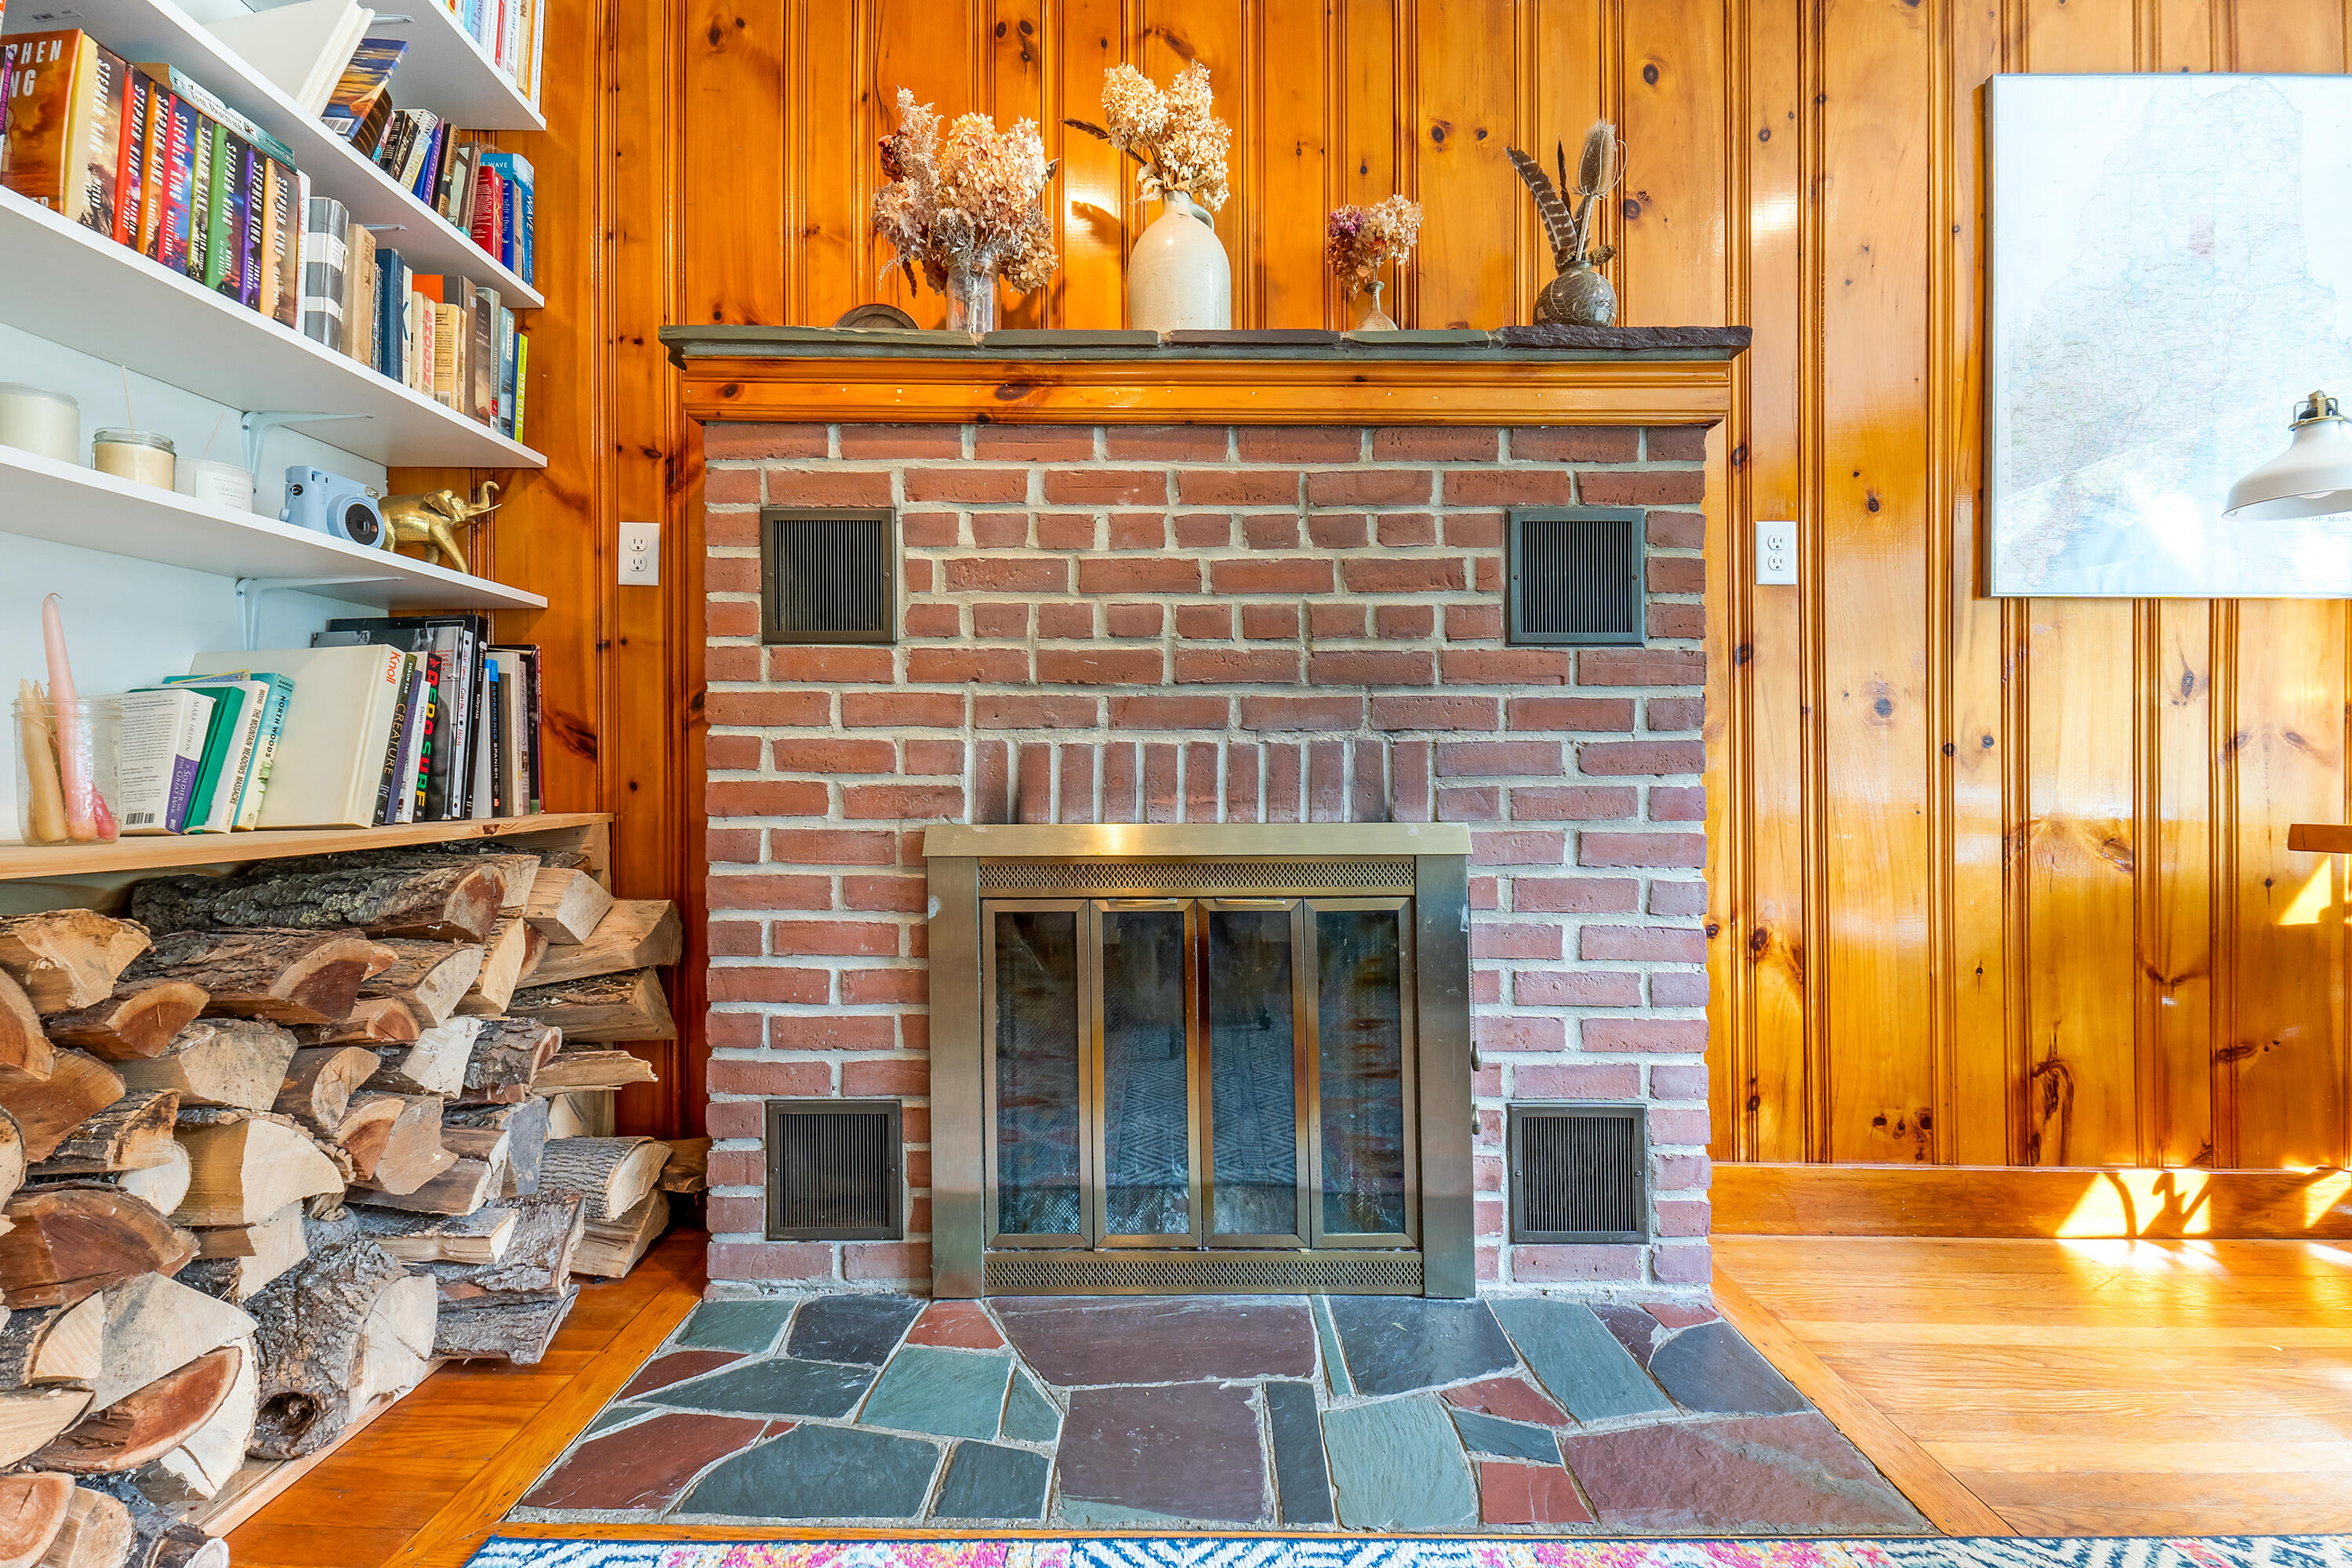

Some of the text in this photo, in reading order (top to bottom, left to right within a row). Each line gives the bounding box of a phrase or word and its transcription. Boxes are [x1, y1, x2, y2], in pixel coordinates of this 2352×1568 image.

[89, 57, 111, 154] STEPHEN KING
[128, 84, 146, 177] STEPHEN KING
[151, 94, 169, 186] STEPHEN KING
[169, 111, 188, 201] STEPHEN KING
[196, 127, 212, 212] STEPHEN KING
[448, 145, 458, 174] GRISHAM
[221, 142, 238, 226] STEPHEN KING
[249, 162, 264, 244] STEPHEN KING
[275, 176, 289, 226] STEPHEN
[164, 210, 176, 256] WASTE LANDS
[274, 228, 287, 256] KING
[423, 310, 433, 387] SHOGUN
[278, 680, 294, 689] DANIEL
[386, 651, 401, 685] Knoll
[405, 662, 413, 682] SHAUN
[277, 684, 292, 693] MASON
[184, 700, 200, 752] MARK HELPRIN
[245, 718, 260, 747] MOUNTAIN
[252, 708, 262, 720] THE
[265, 695, 287, 759] NORTH WOODS
[383, 703, 406, 775] CREATURE
[238, 746, 252, 775] MEADOWS
[172, 770, 183, 797] GREAT
[178, 769, 191, 803] SOLDIER
[230, 775, 244, 805] MASSACRE
[170, 796, 179, 814] WAR
